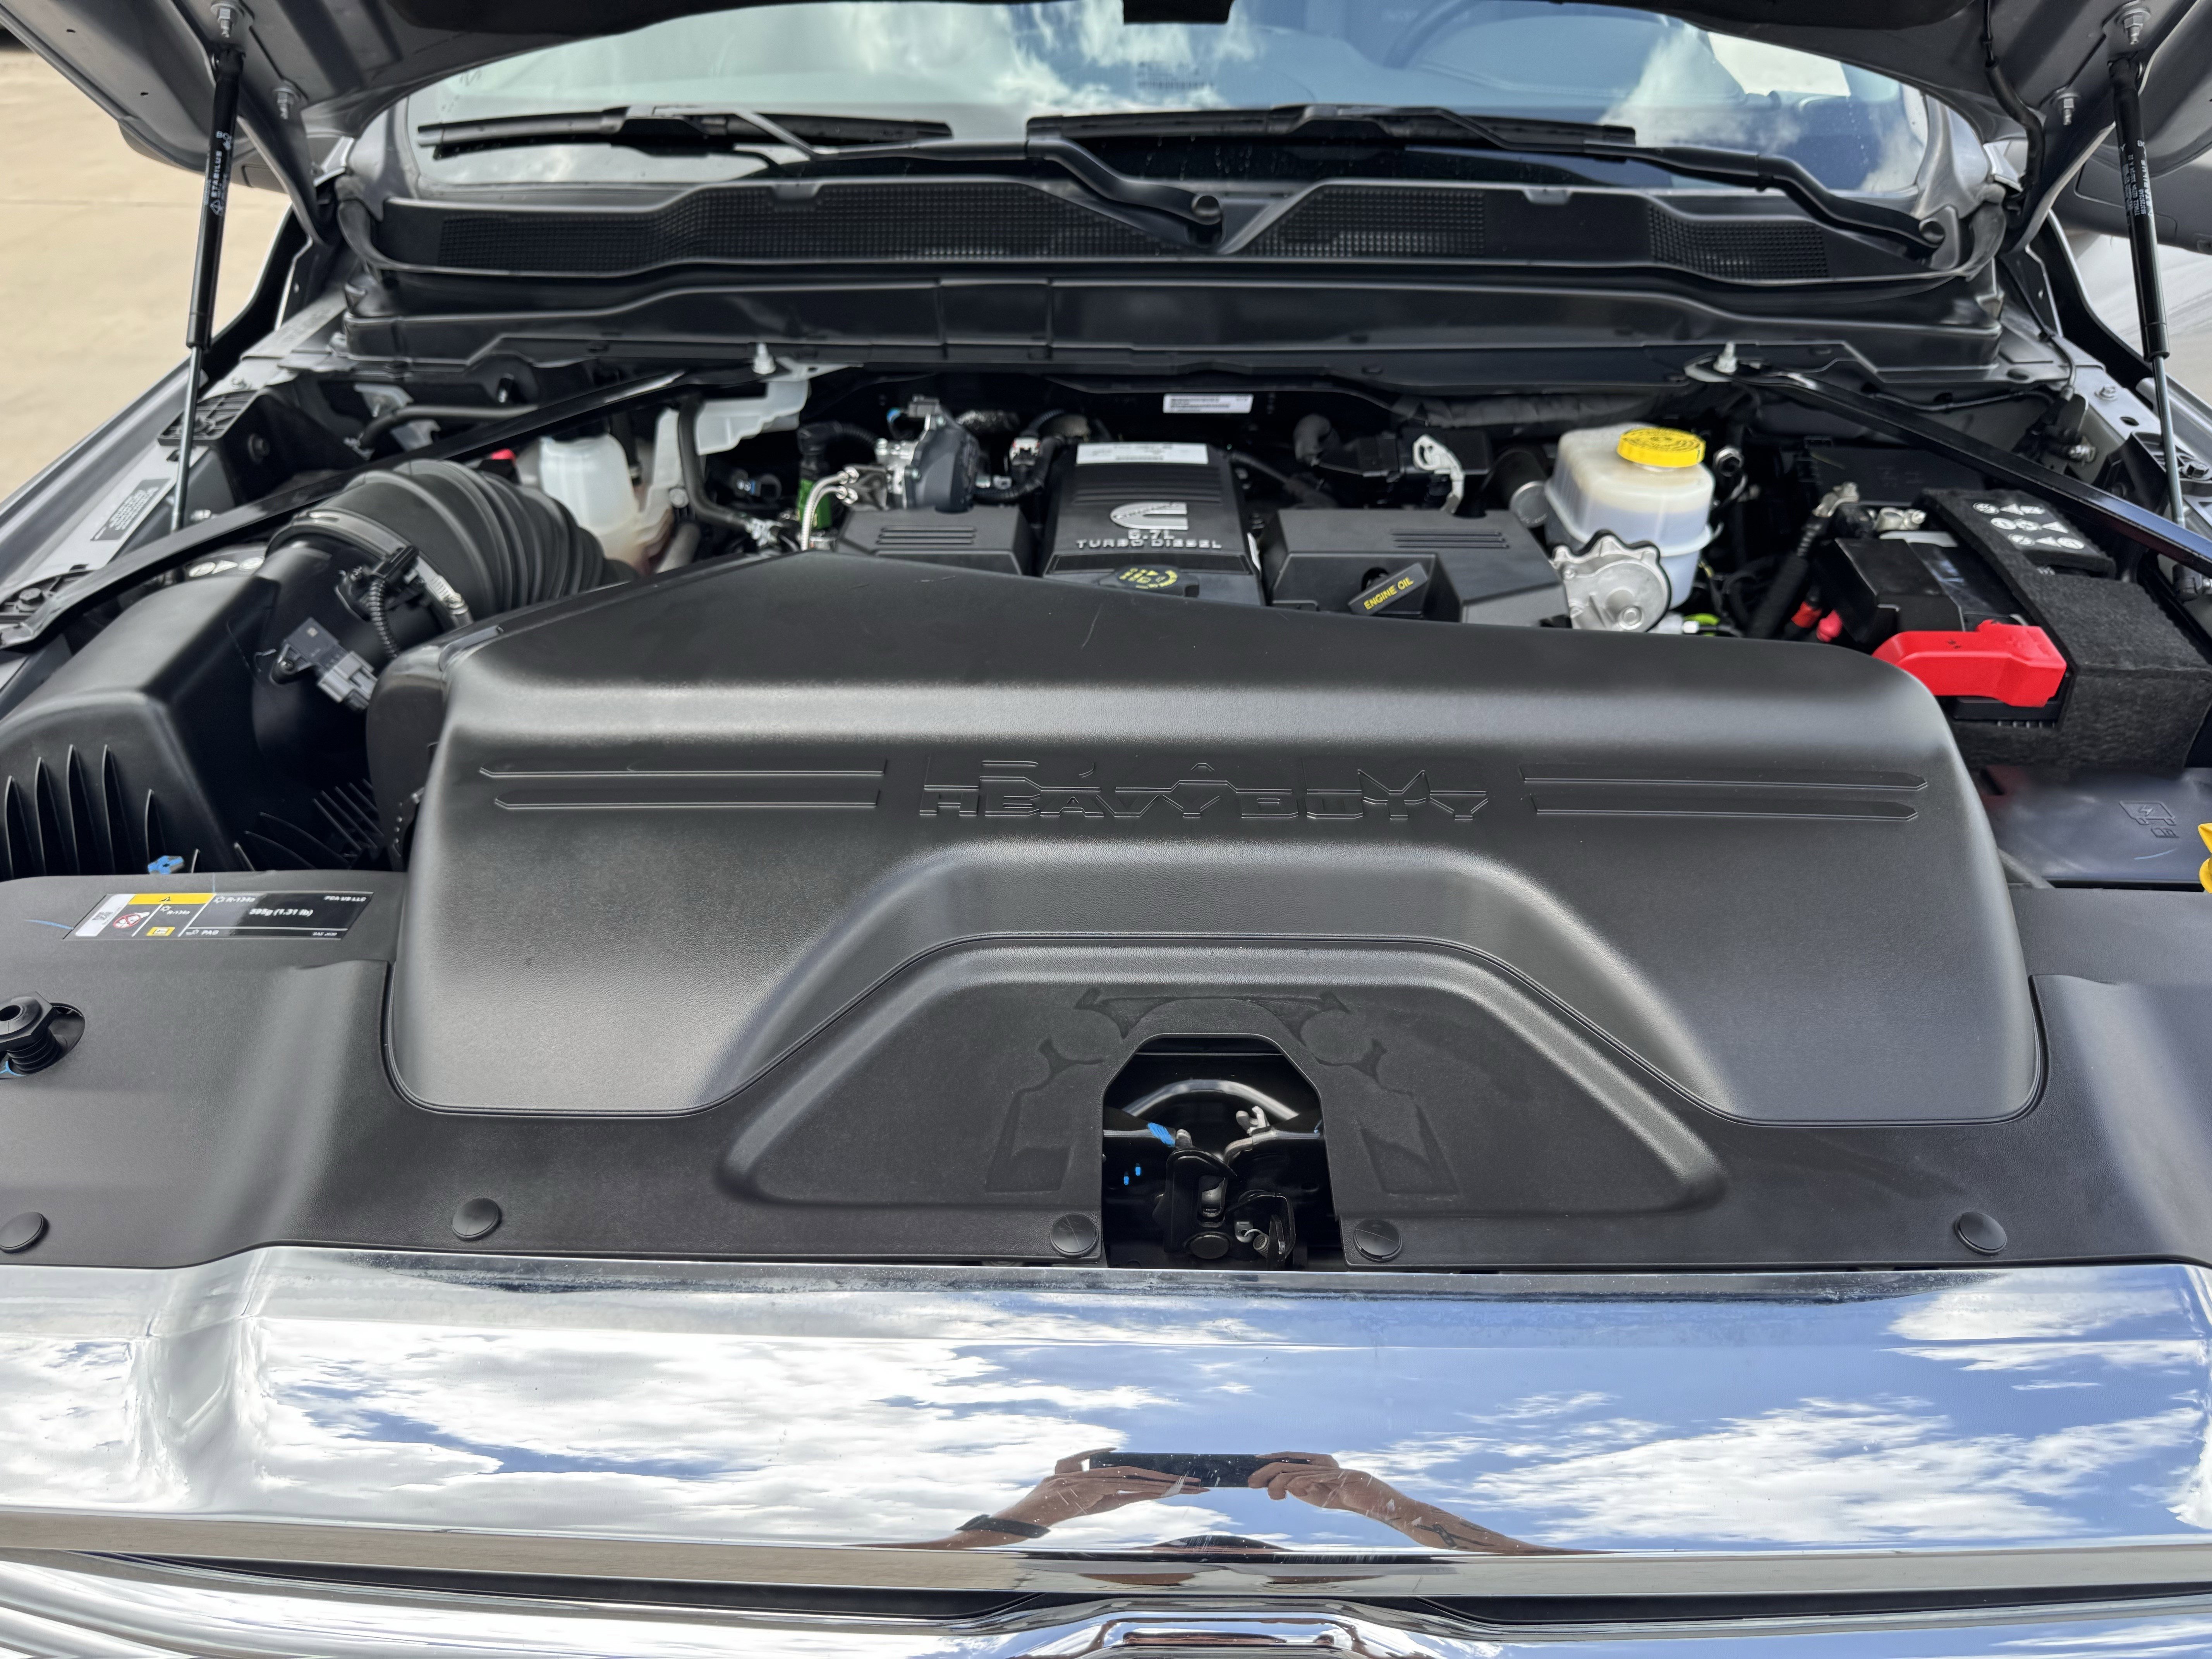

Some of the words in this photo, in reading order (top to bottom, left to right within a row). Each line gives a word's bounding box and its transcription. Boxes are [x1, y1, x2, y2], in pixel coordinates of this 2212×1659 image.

[210, 150, 223, 198] STABILUS
[1076, 539, 1144, 549] TURBO
[1151, 539, 1223, 549] DIESEL
[1127, 529, 1175, 540] 6.7L
[1364, 585, 1398, 610] ENGINE
[1397, 577, 1414, 590] OIL
[919, 793, 1221, 819] HEAVY
[1240, 794, 1489, 820] DUTY
